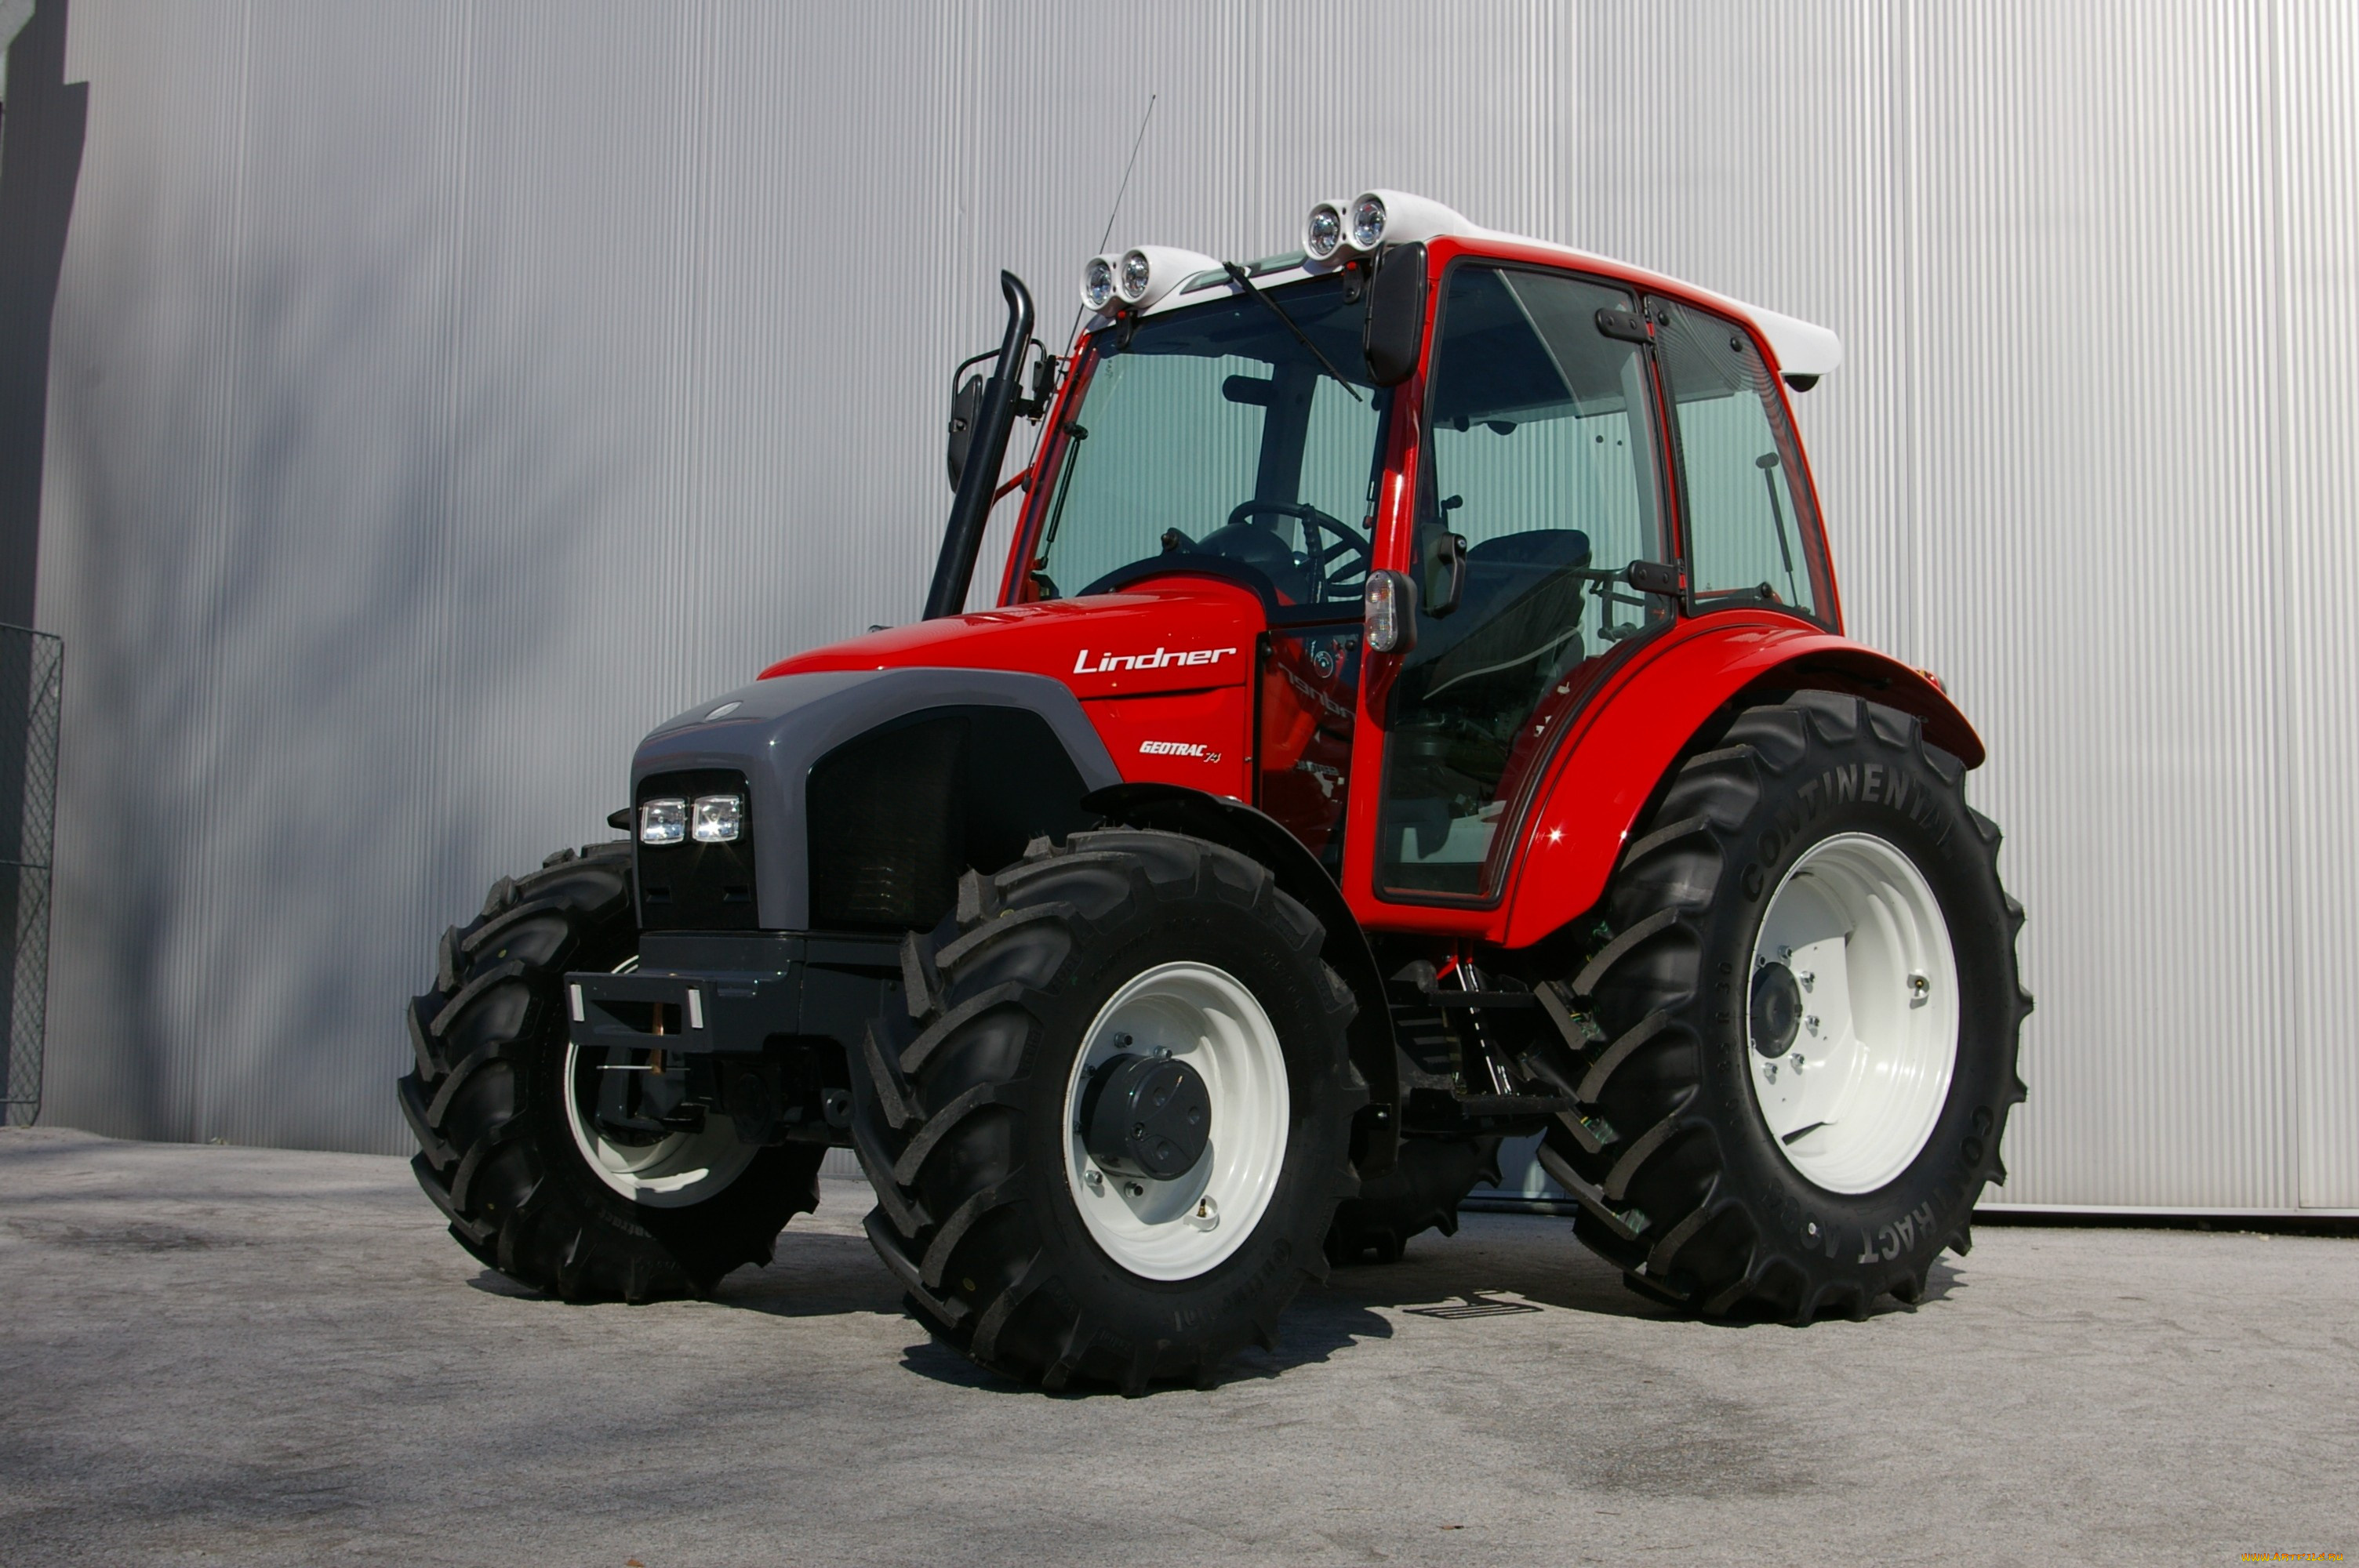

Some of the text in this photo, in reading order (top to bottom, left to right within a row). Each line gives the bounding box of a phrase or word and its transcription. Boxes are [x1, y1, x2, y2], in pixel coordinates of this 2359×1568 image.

[1073, 647, 1237, 674] Lindner
[1140, 740, 1208, 757] GEOTRAC
[1739, 764, 1957, 902] CONTINENTAL
